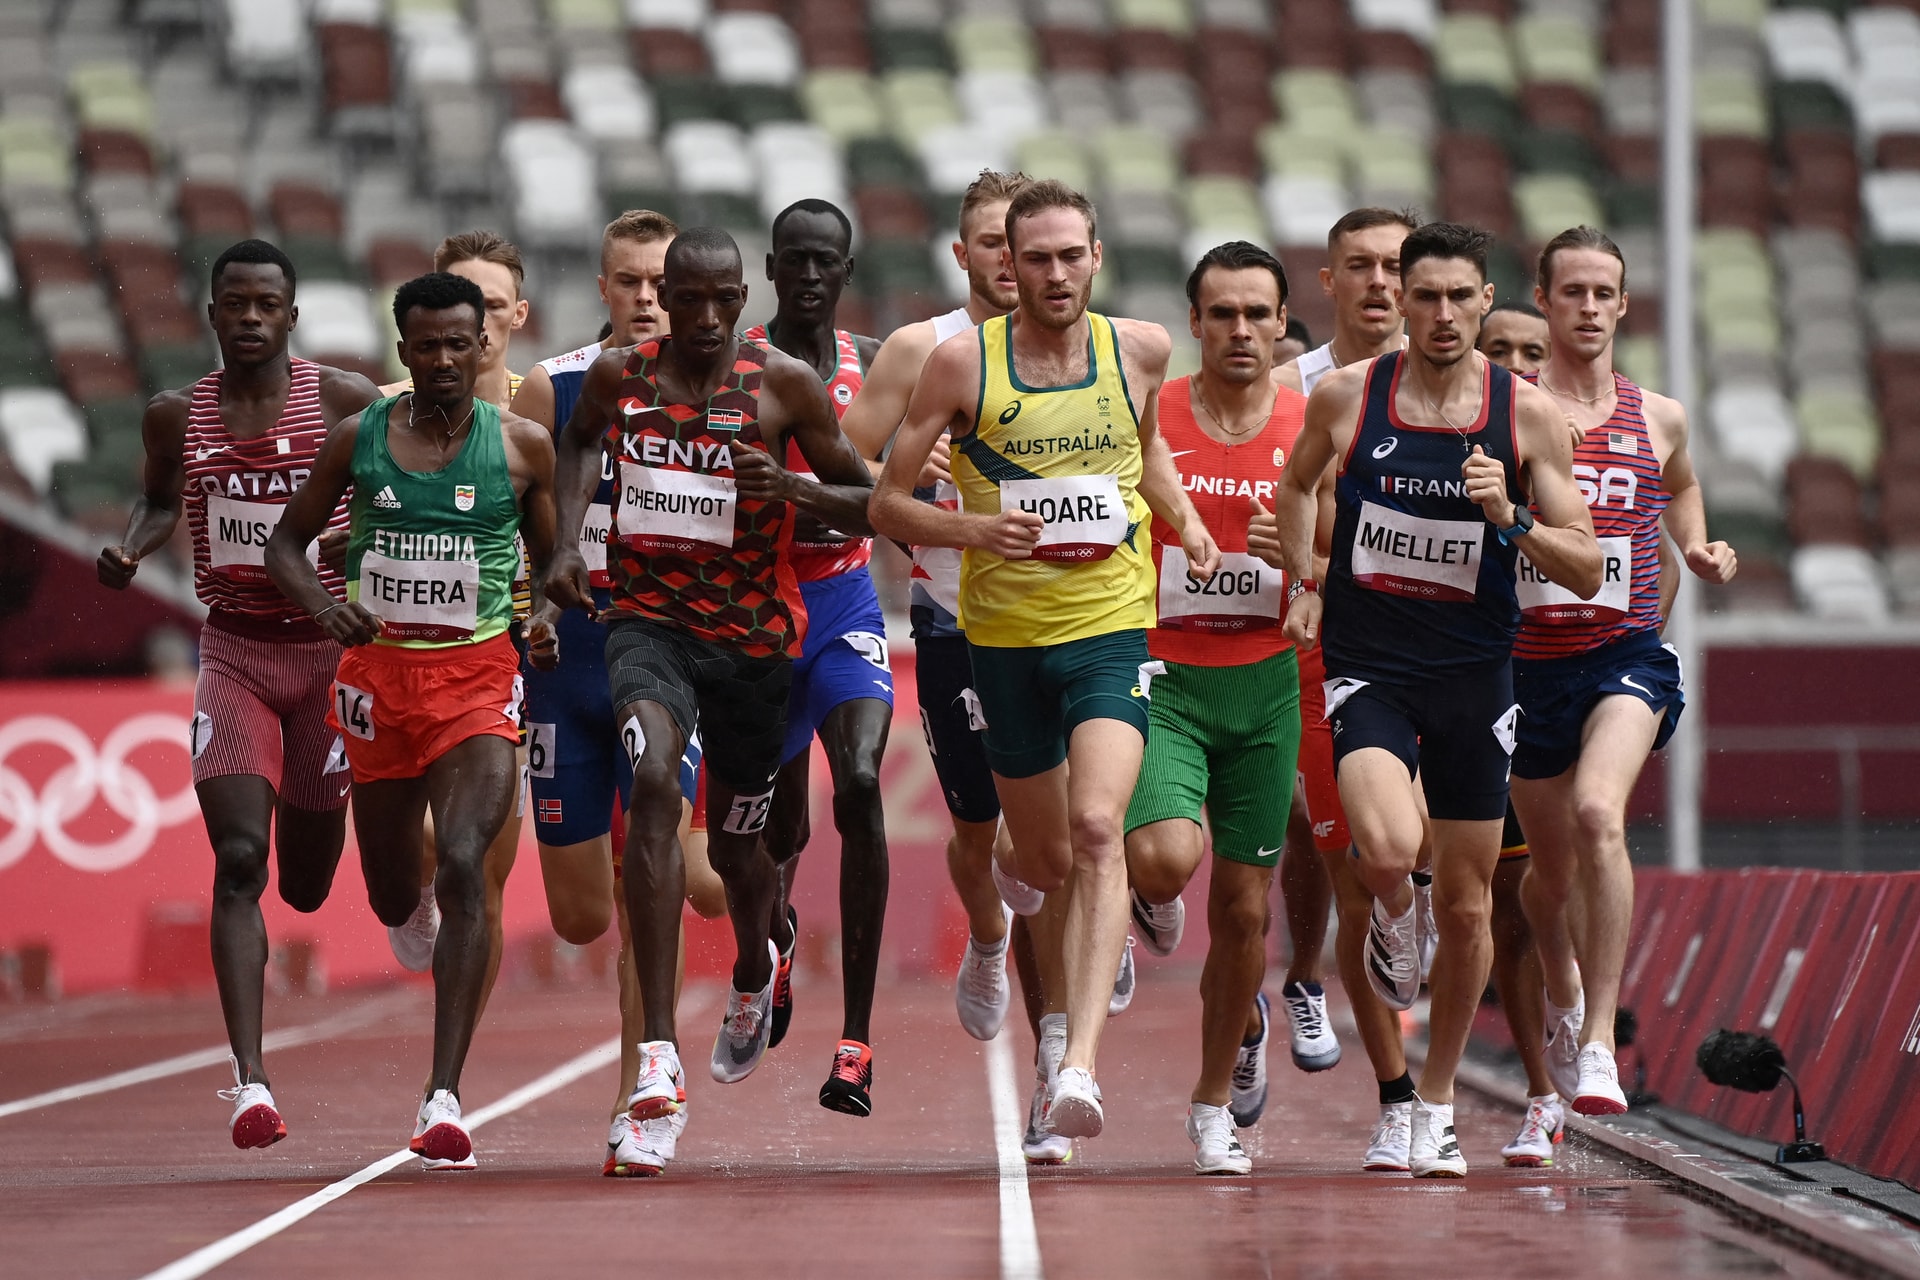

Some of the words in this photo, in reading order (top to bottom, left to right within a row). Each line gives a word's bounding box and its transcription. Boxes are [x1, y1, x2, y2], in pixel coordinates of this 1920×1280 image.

[622, 432, 735, 471] KENYA
[1003, 434, 1112, 455] AUSTRALIA
[626, 485, 727, 517] CHERUIYOT
[1178, 473, 1279, 499] UNGAR
[1572, 465, 1638, 509] SA
[373, 500, 402, 508] adidas
[1020, 495, 1110, 523] HOARE
[219, 516, 278, 547] MUS
[375, 529, 475, 560] ETHIOPIA
[1360, 522, 1477, 565] MIELLET
[369, 571, 466, 605] TEFERA
[1185, 570, 1260, 596] SZOGI
[1385, 580, 1403, 590] TOKYO
[1404, 584, 1418, 592] 2020
[387, 628, 405, 636] TOKYO
[337, 688, 369, 735] 14
[736, 796, 771, 831] 12
[1312, 819, 1336, 838] 4F
